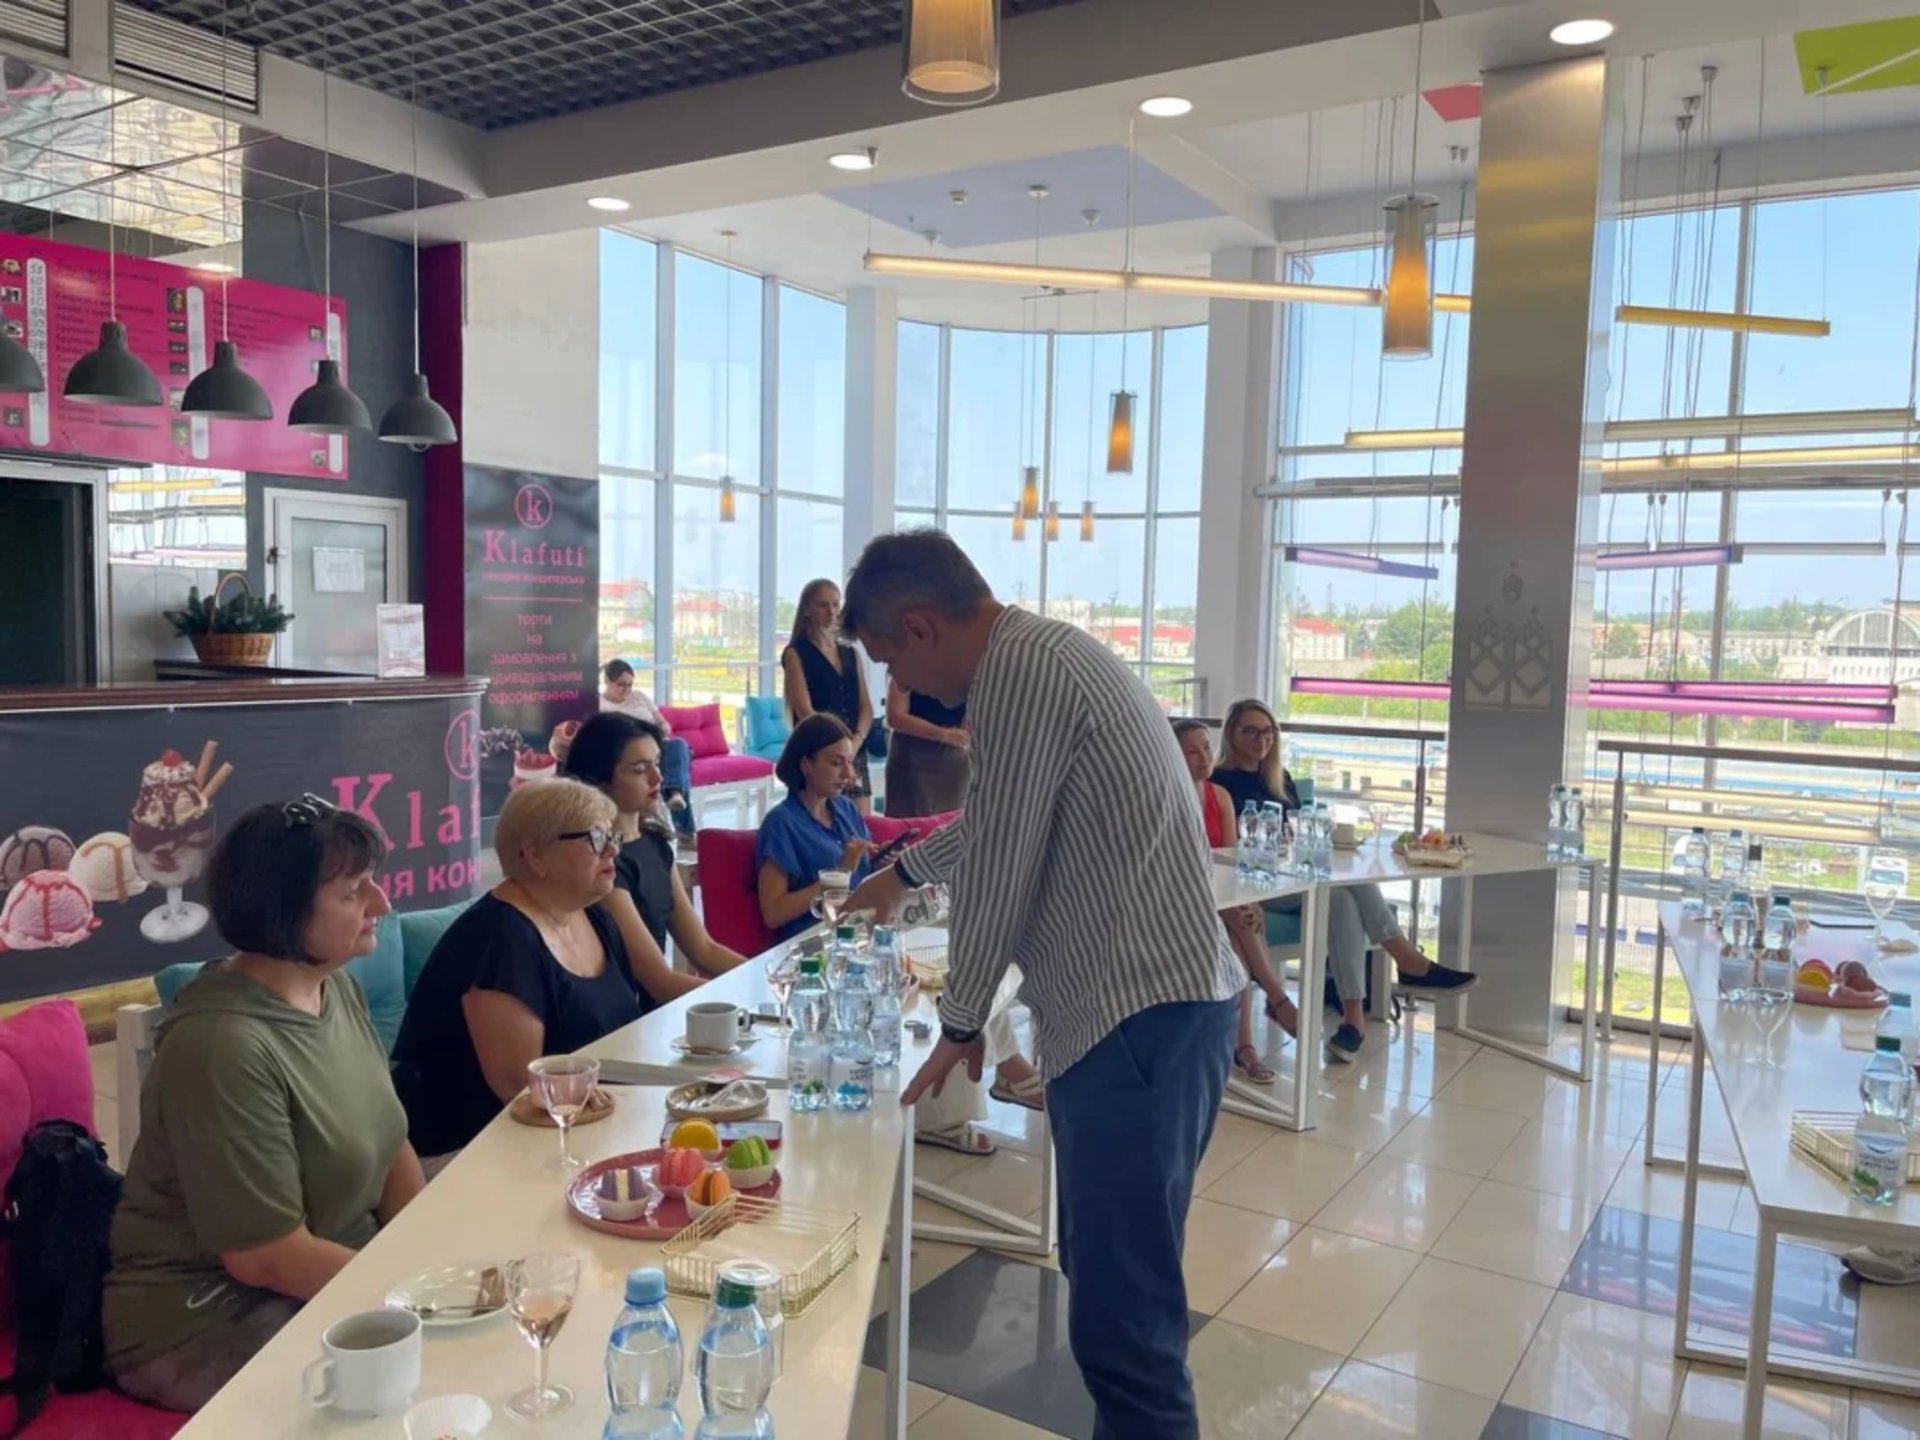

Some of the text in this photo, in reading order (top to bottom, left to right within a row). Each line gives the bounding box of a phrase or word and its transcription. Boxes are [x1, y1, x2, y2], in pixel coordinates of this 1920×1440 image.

[525, 489, 542, 521] k
[483, 529, 584, 567] Klafuti
[517, 613, 551, 627] торти
[527, 633, 543, 645] на
[490, 652, 567, 665] замовлення
[488, 690, 579, 705] оформленням
